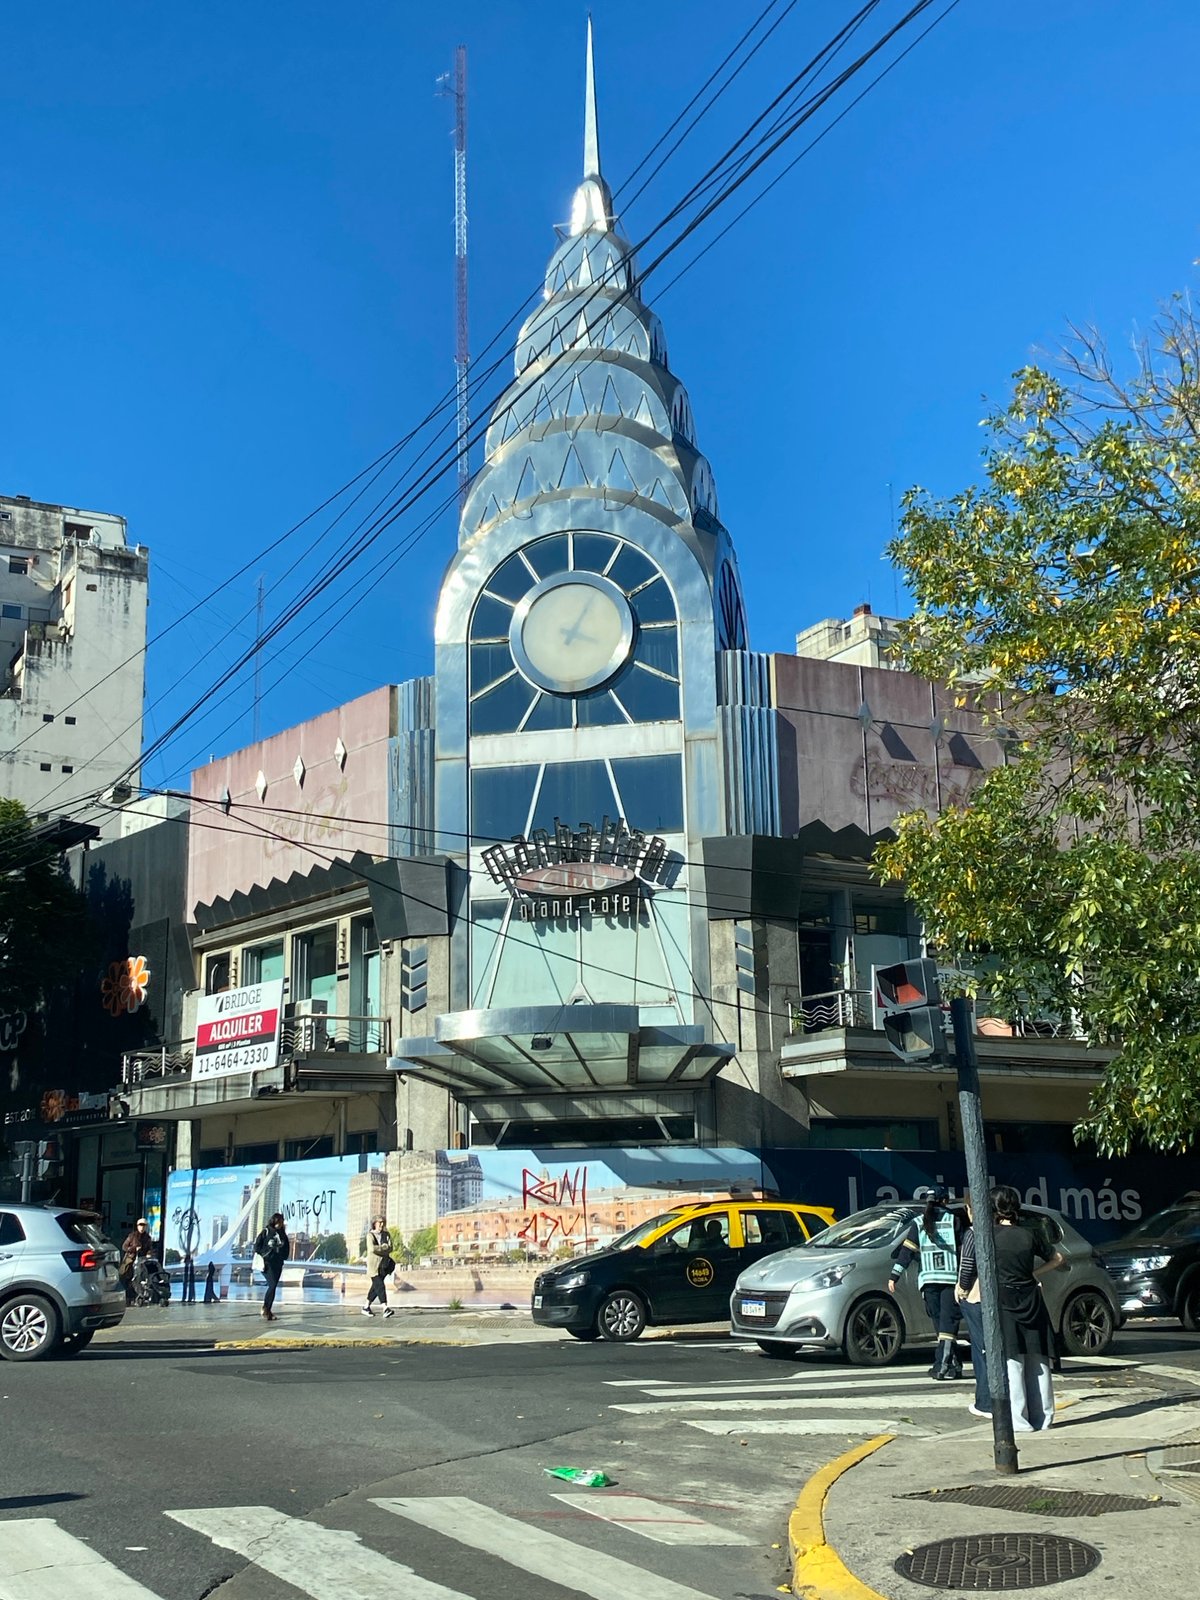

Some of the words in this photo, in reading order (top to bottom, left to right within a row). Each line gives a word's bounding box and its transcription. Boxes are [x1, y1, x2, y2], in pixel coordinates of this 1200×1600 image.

[539, 866, 609, 892] Club
[520, 897, 573, 923] grand
[224, 988, 262, 1011] BRIDGE
[209, 1014, 263, 1042] ALQUILER
[198, 1046, 269, 1074] 11-6464-2330
[296, 1199, 311, 1219] THE
[312, 1190, 337, 1222] CAT
[1059, 1178, 1142, 1220] más
